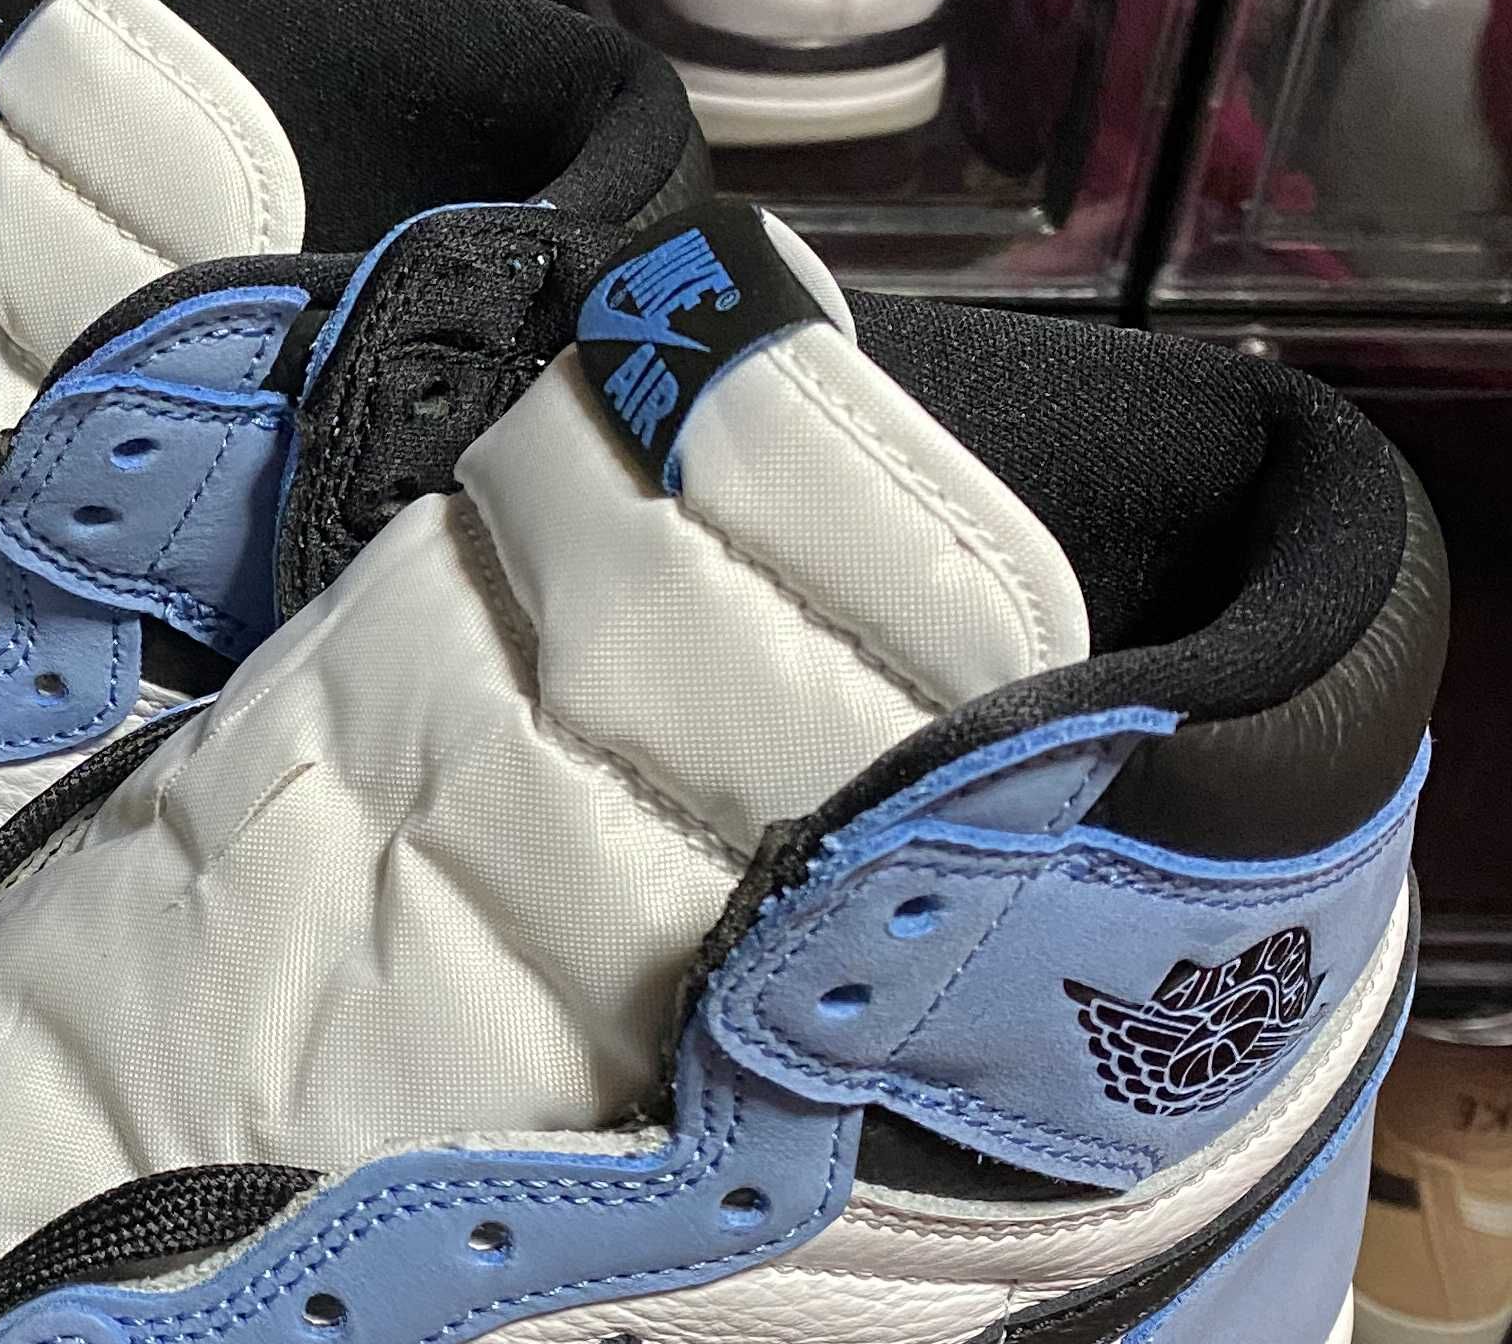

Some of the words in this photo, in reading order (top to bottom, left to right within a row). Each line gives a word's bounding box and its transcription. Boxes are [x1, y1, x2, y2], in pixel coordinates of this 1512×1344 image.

[621, 226, 736, 328] NIKE
[603, 342, 679, 449] AIR
[1161, 957, 1242, 1009] AIR
